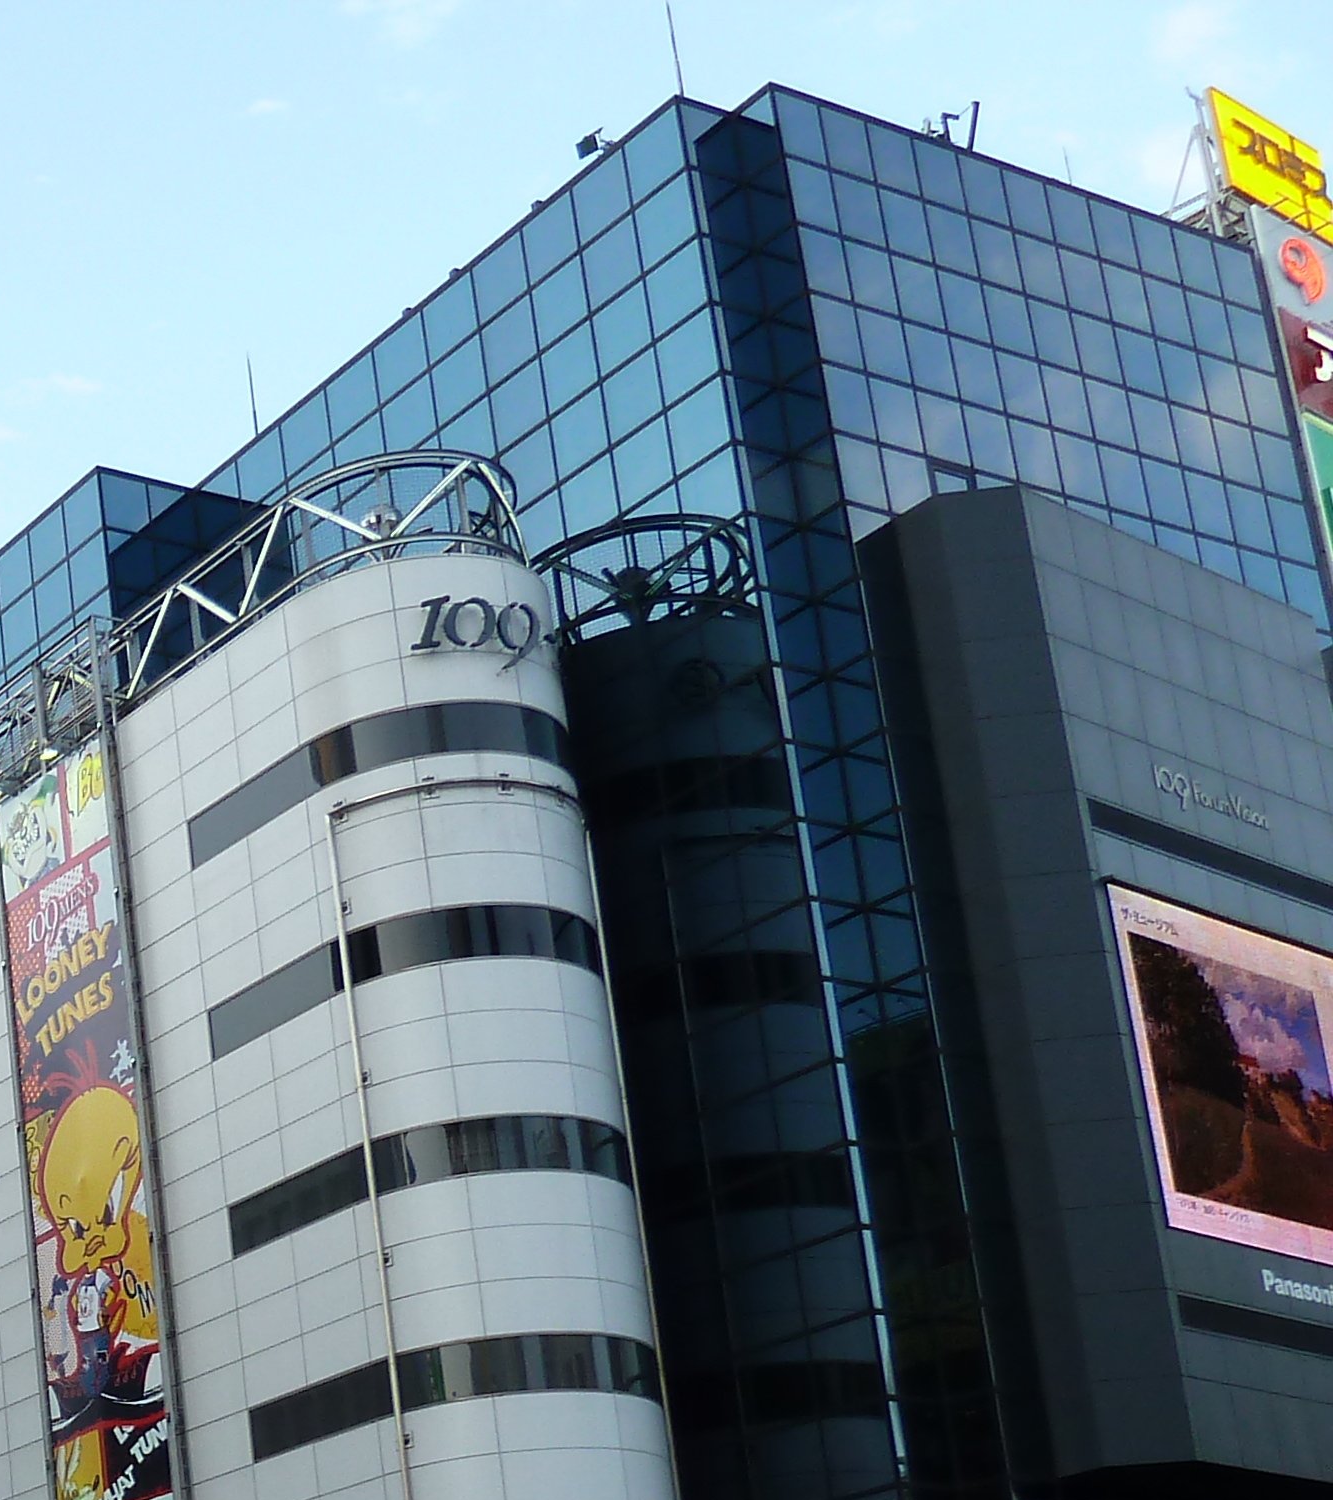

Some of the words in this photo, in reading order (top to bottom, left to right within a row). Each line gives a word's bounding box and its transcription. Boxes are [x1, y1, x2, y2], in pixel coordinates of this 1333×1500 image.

[26, 899, 60, 951] 109
[16, 922, 113, 1026] LOONEY
[35, 971, 114, 1057] TUNES
